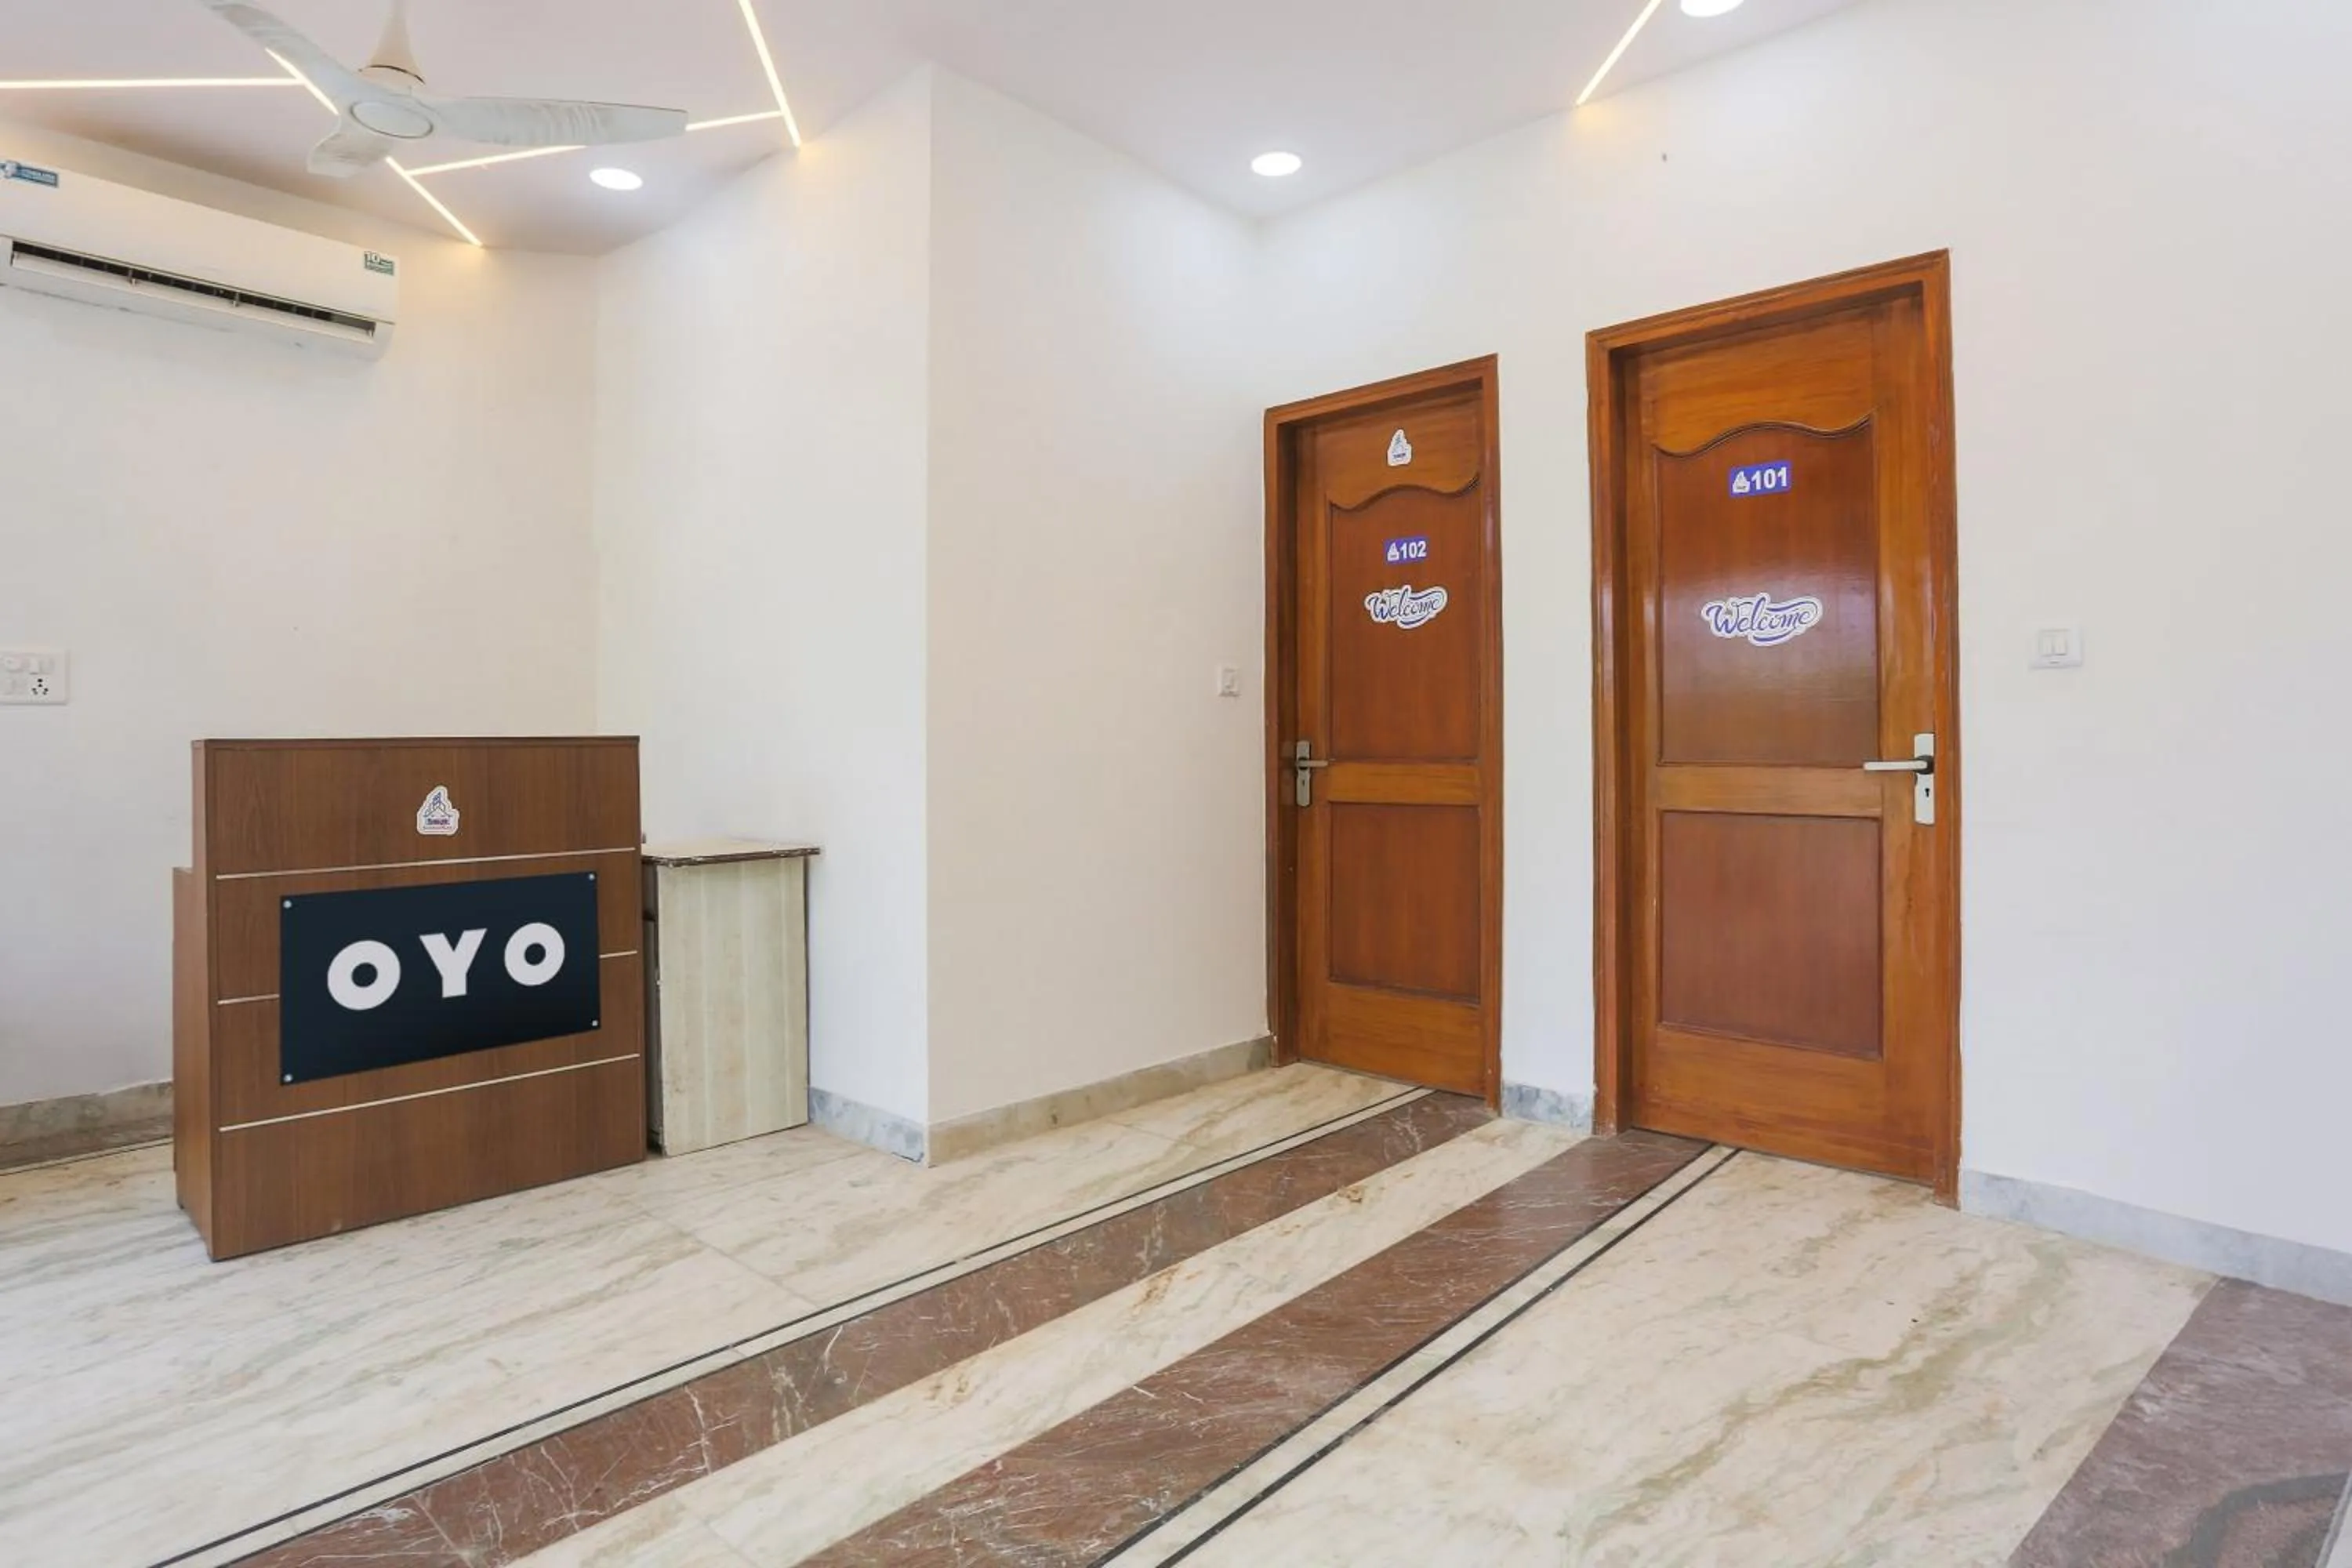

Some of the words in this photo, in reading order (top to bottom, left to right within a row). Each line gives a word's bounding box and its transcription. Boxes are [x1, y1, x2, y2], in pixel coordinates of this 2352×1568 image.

[1751, 466, 1788, 490] 101
[1400, 540, 1427, 559] 102
[1367, 587, 1444, 621] Welcome
[1705, 596, 1817, 637] Welcome
[327, 922, 565, 1011] OYO
